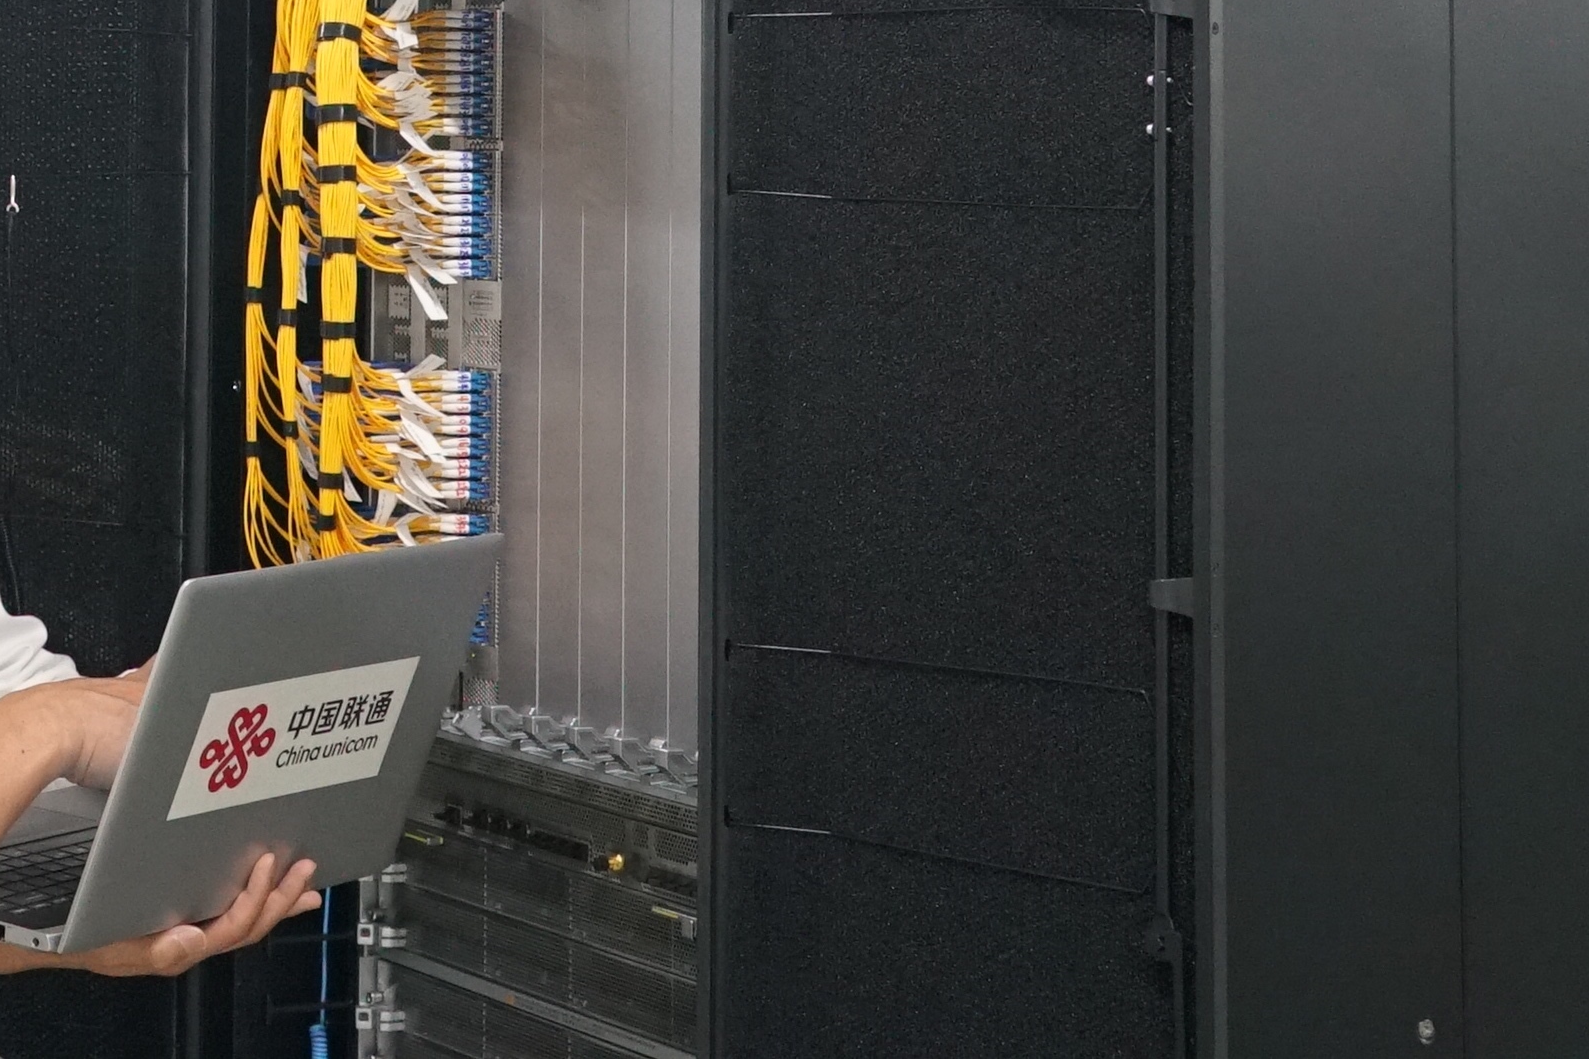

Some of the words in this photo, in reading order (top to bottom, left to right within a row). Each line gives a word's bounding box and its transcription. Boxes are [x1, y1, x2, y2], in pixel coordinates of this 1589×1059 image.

[287, 690, 394, 740] 中国联通
[322, 733, 379, 759] unicom
